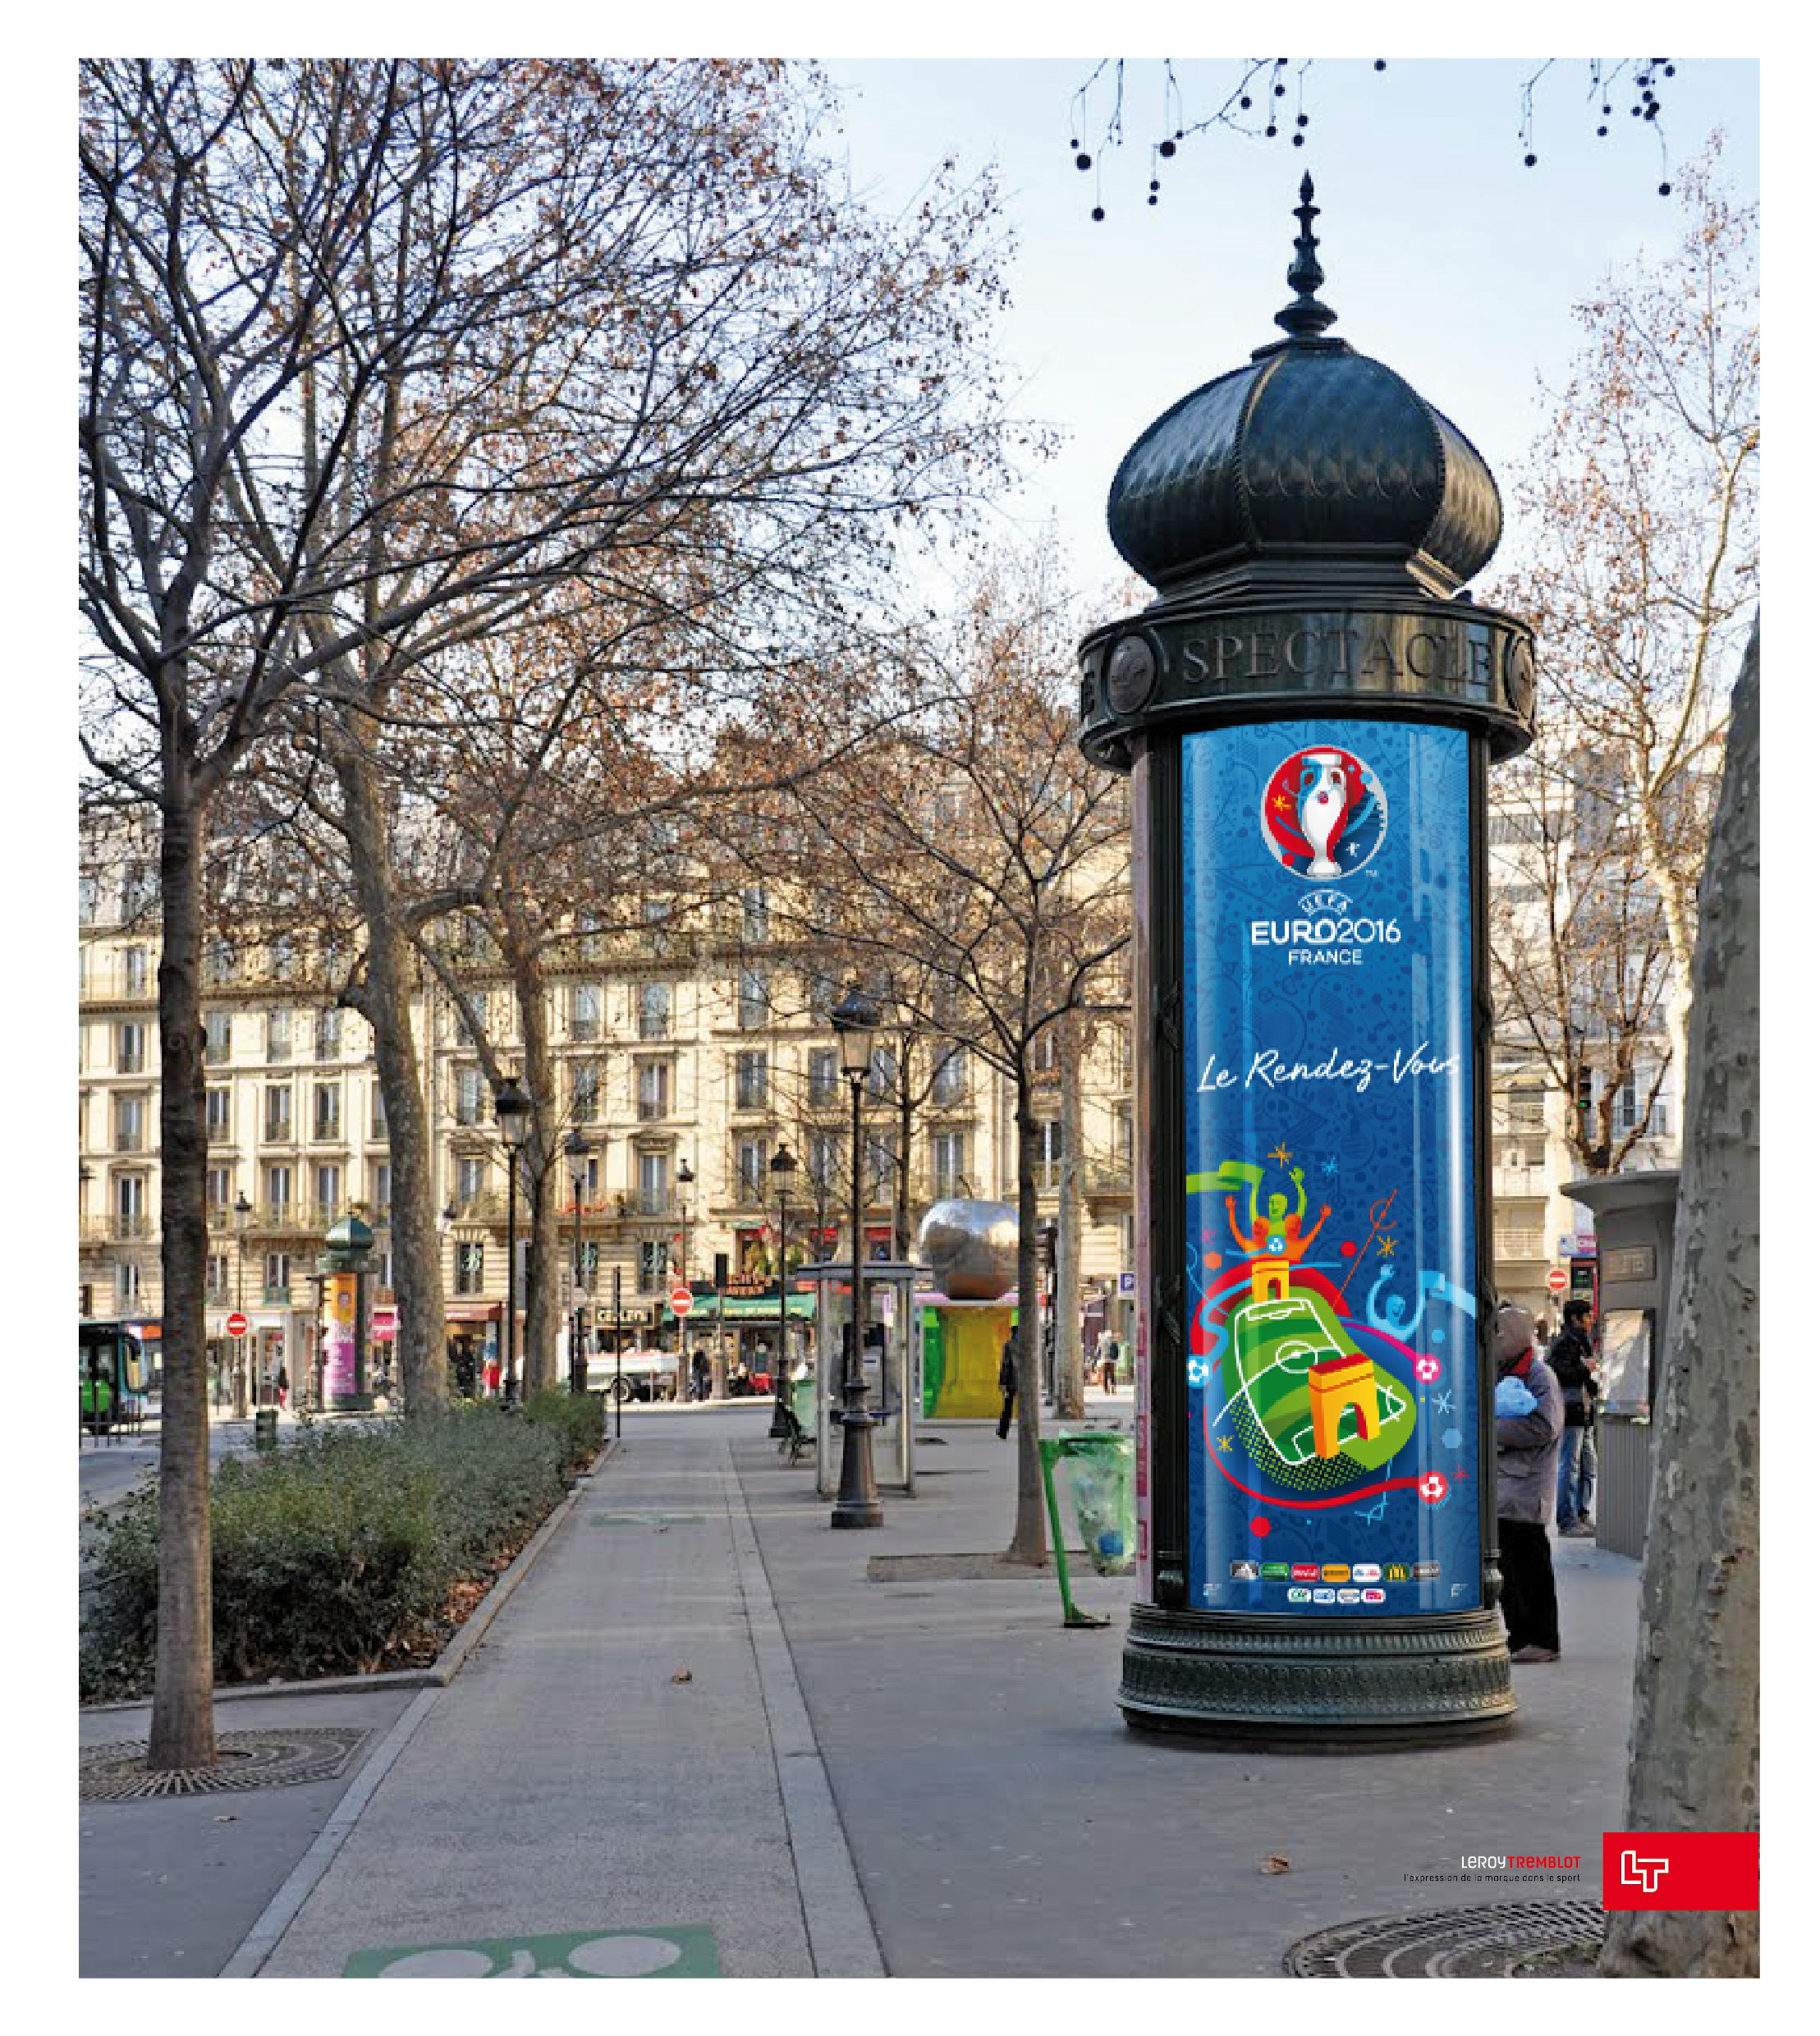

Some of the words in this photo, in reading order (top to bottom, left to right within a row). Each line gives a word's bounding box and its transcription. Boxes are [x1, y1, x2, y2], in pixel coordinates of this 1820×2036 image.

[1182, 630, 1492, 686] SPECTACLE
[1298, 889, 1353, 916] UEFA
[1251, 919, 1401, 945] EURO2016
[1288, 949, 1364, 965] FRANCE
[1197, 1054, 1238, 1093] Le
